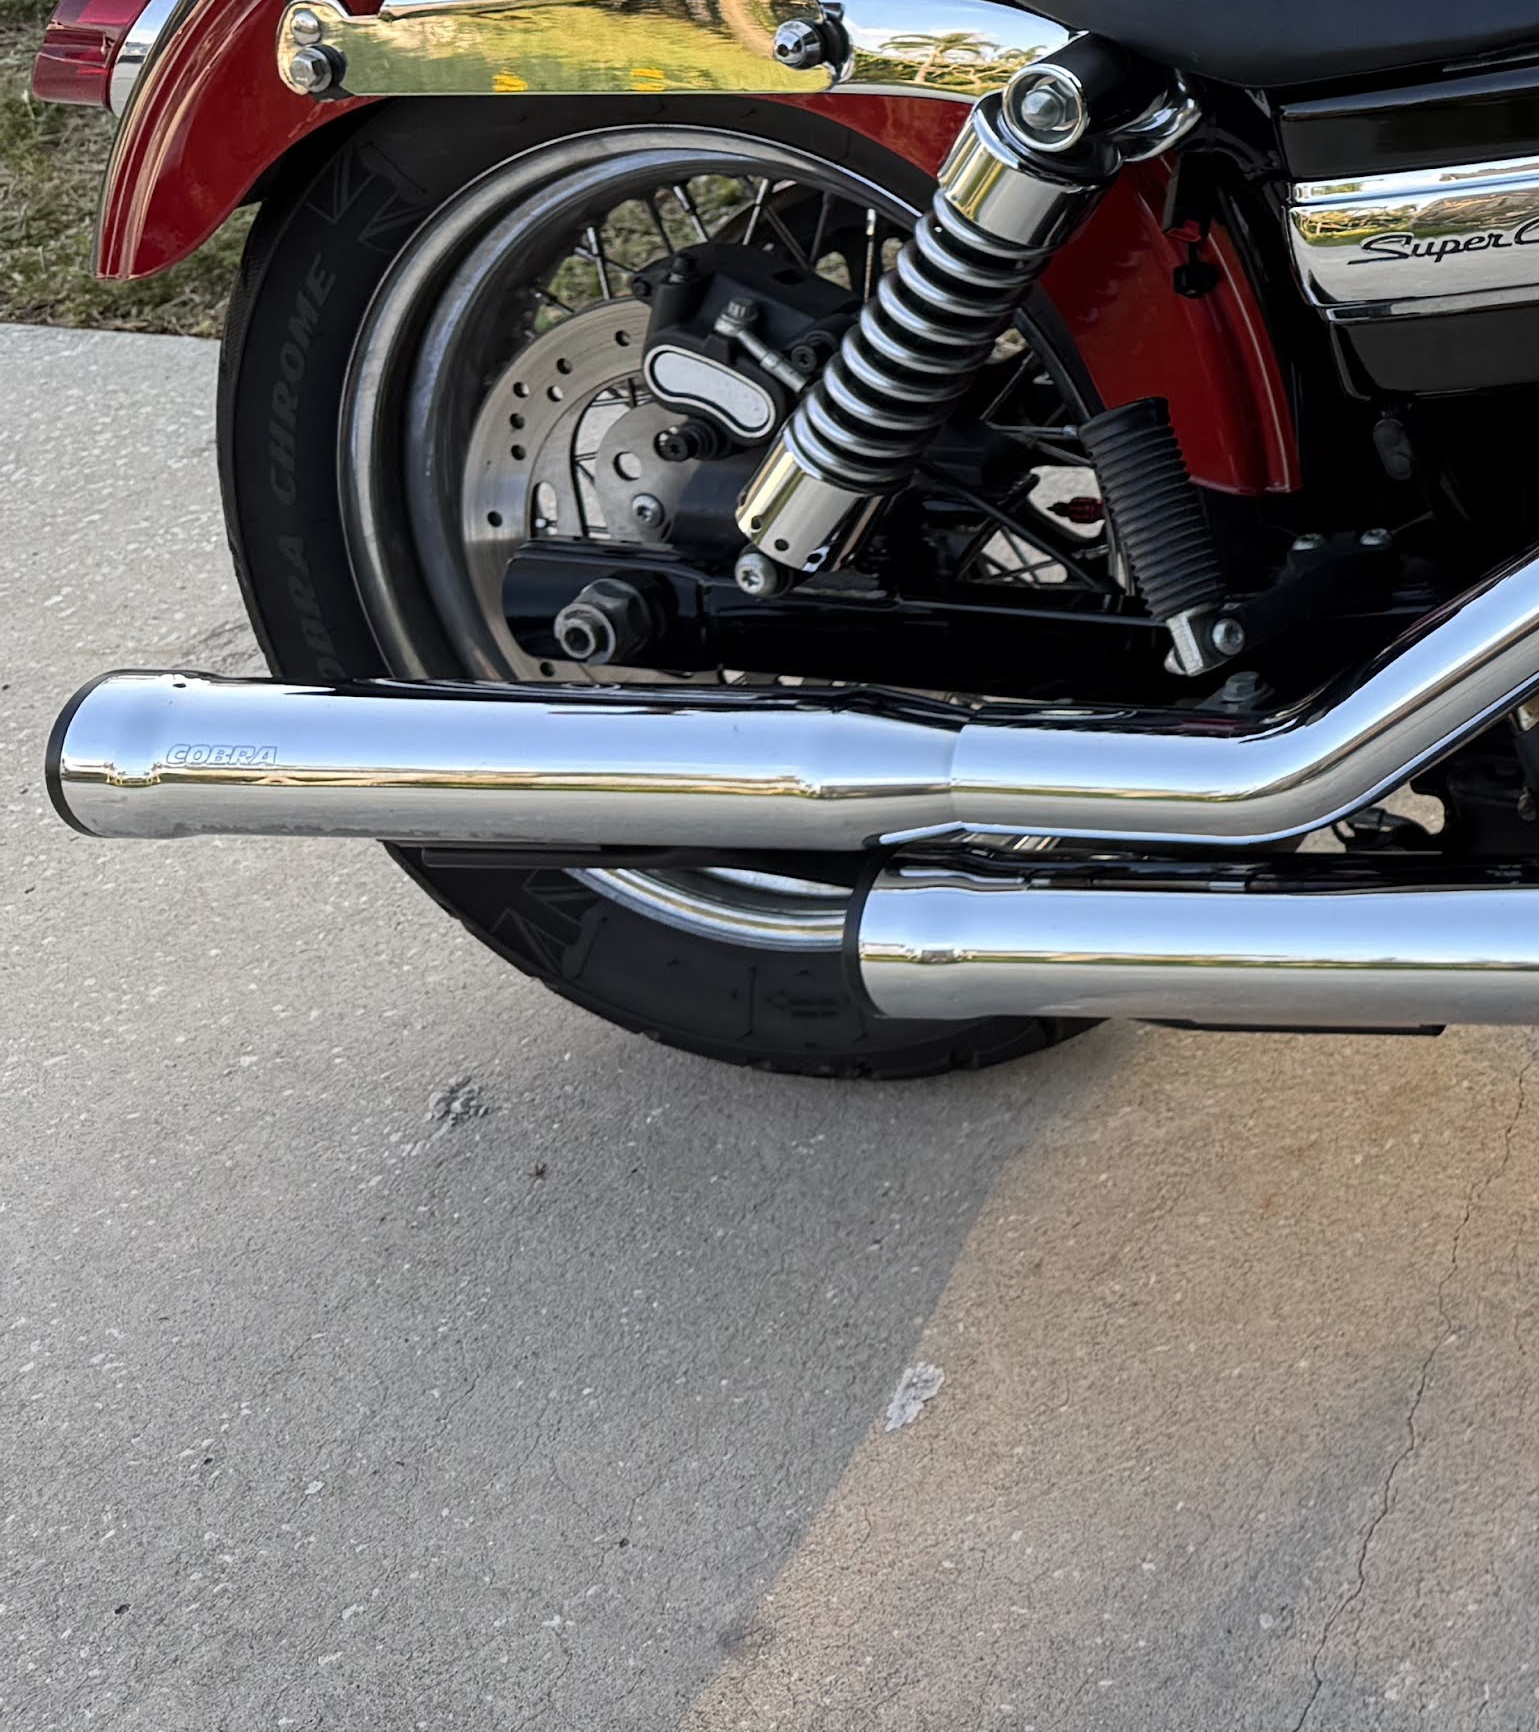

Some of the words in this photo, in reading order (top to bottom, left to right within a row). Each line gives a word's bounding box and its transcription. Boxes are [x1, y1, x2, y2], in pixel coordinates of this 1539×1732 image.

[1348, 231, 1512, 264] Super
[267, 253, 336, 506] CHROME
[165, 743, 278, 768] COBRA
